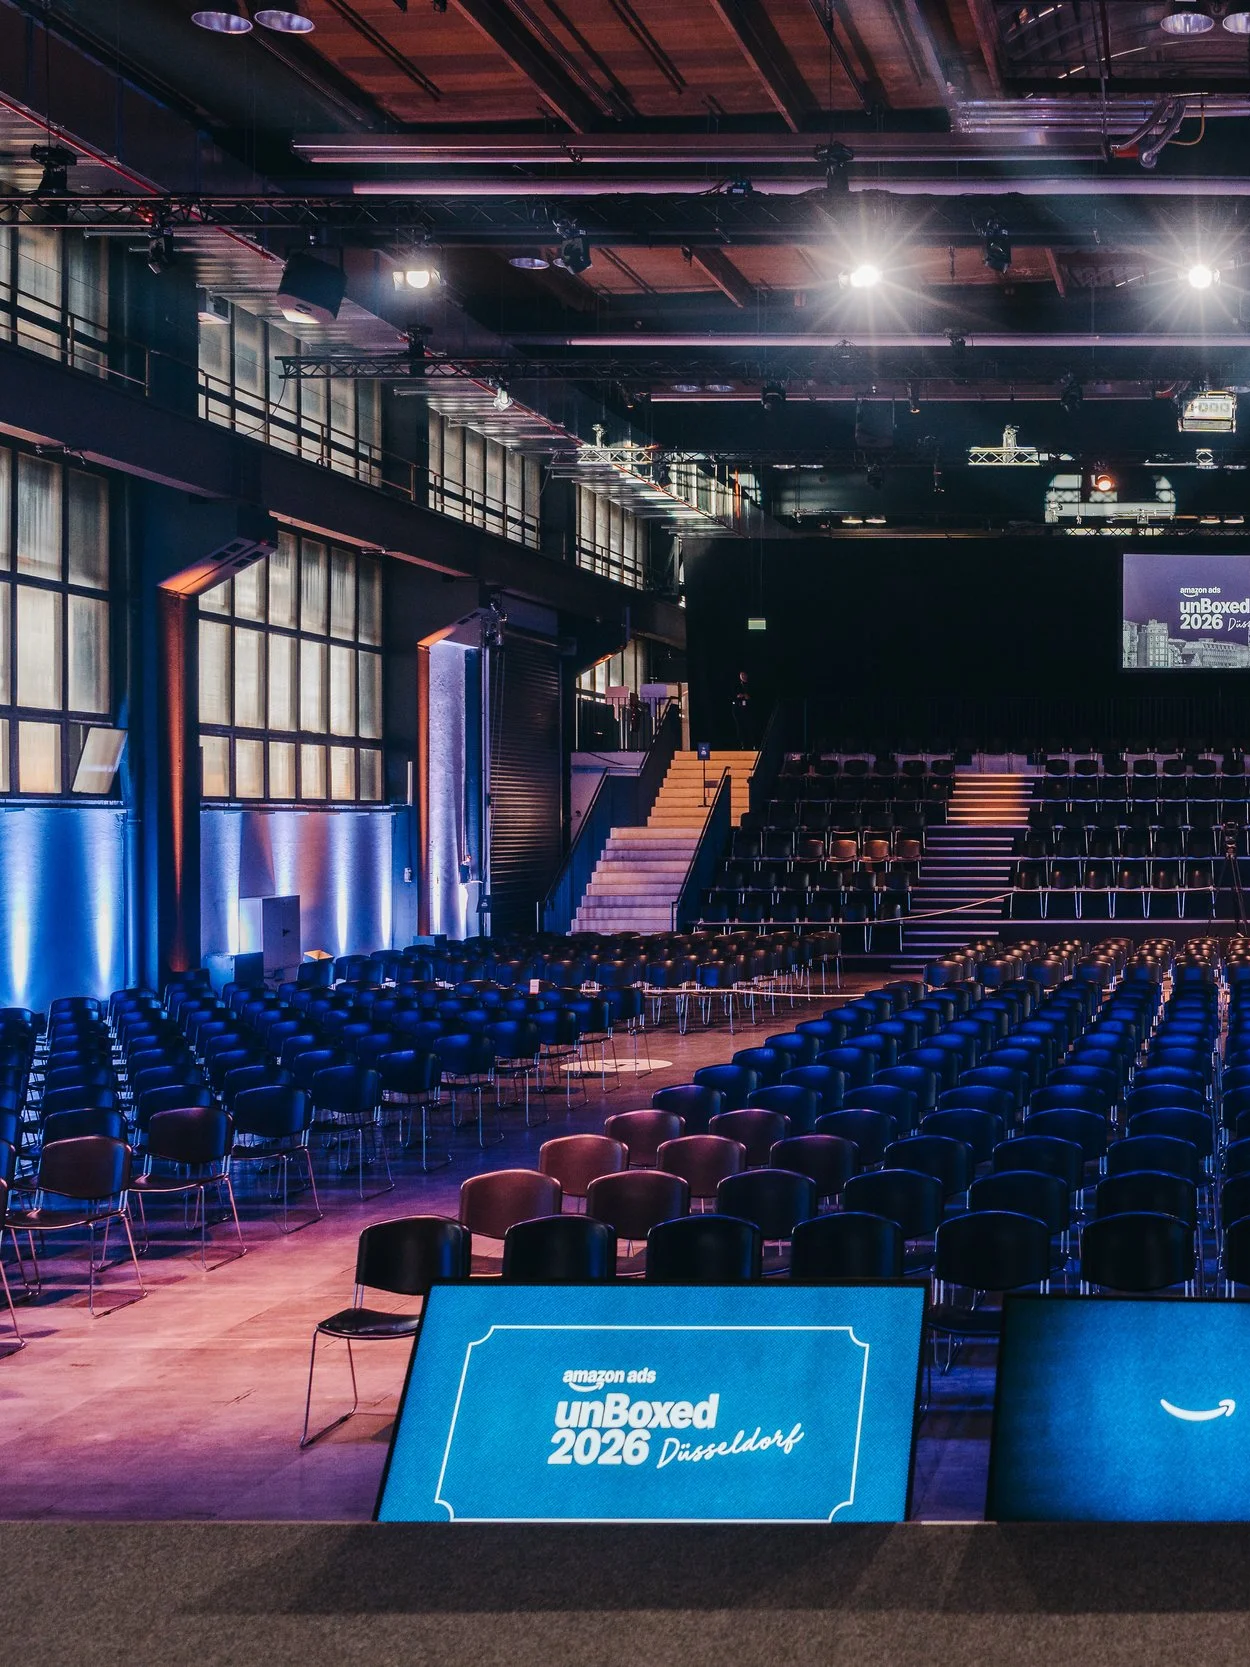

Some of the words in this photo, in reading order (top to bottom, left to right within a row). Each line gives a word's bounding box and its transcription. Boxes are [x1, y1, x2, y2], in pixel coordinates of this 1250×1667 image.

[1180, 598, 1250, 614] unBoxed
[1180, 614, 1223, 630] 2026
[563, 1370, 625, 1385] amazon
[627, 1367, 656, 1384] ads
[554, 1393, 720, 1428] unBoxed
[548, 1428, 651, 1466] 2026
[656, 1422, 805, 1469] Düsseldorf
